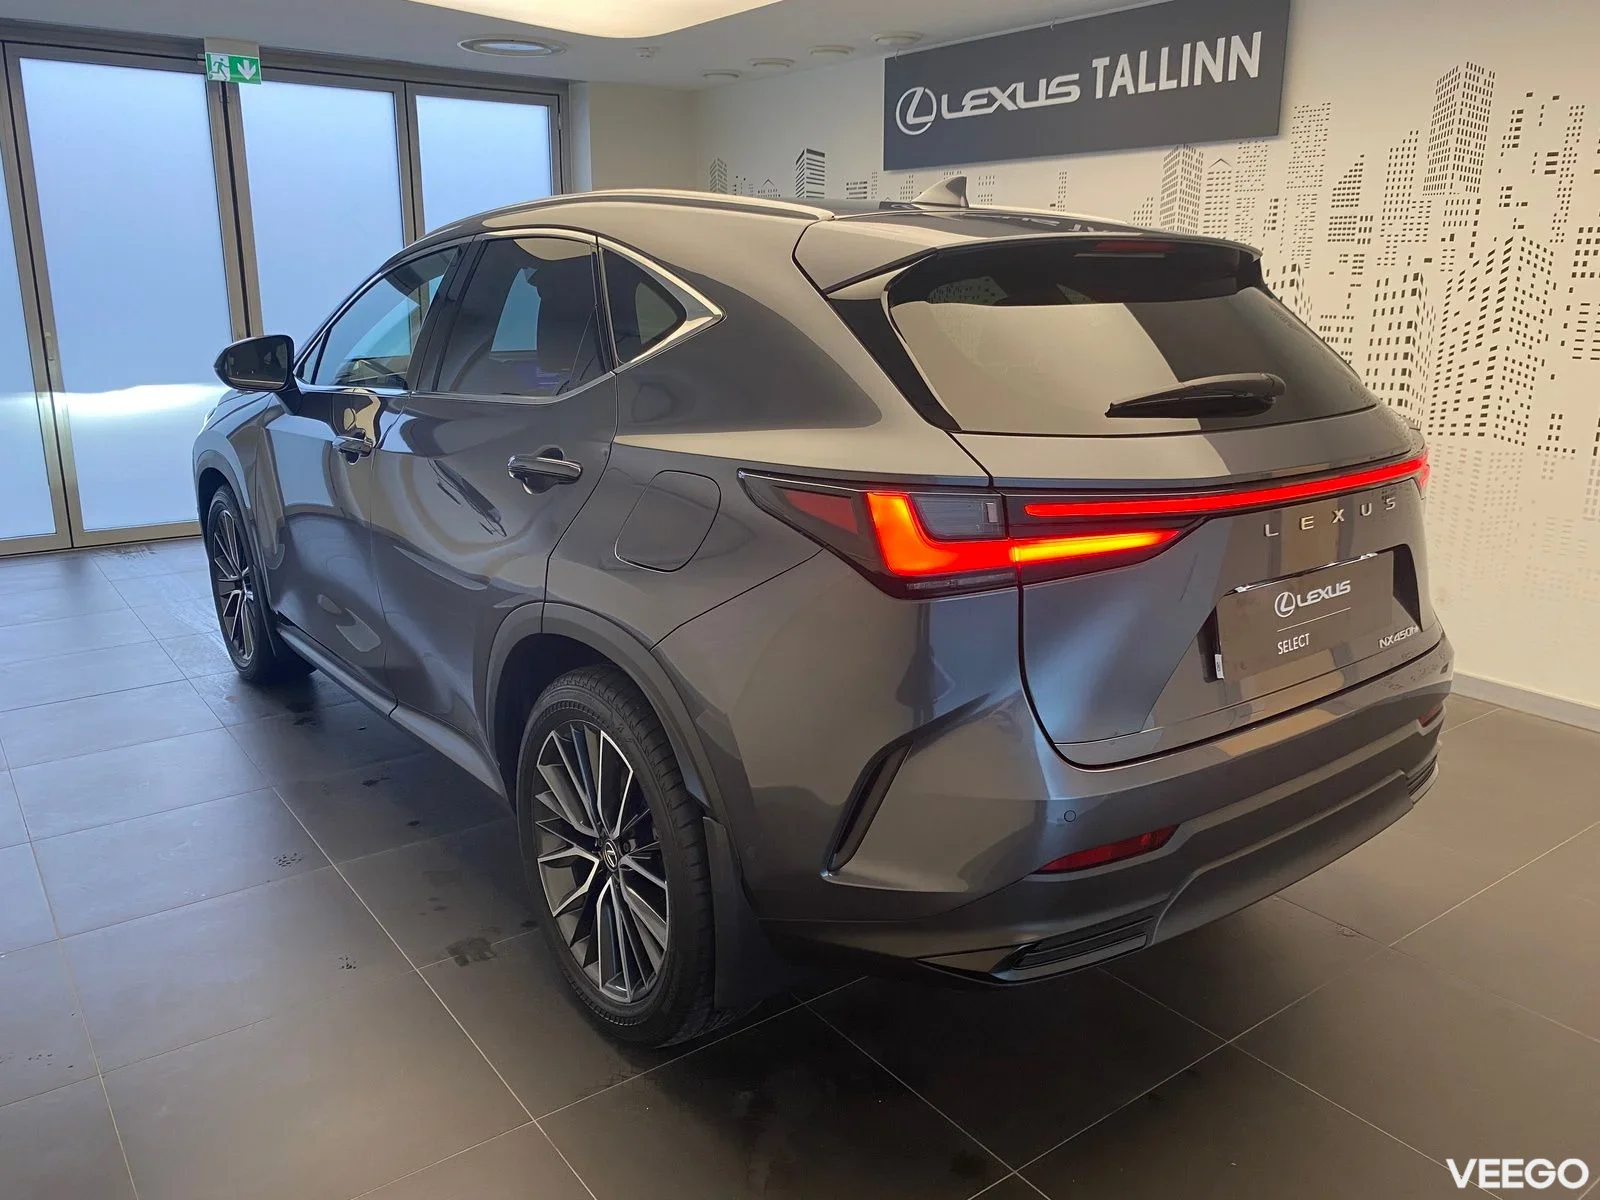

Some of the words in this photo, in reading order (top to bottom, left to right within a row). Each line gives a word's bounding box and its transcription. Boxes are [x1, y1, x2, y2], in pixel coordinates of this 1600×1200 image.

[942, 74, 1080, 119] LEXUS
[1092, 31, 1262, 99] TALLINN
[1264, 497, 1396, 537] LEXUS
[1296, 580, 1351, 607] LEXUS
[1277, 633, 1310, 655] SELECT
